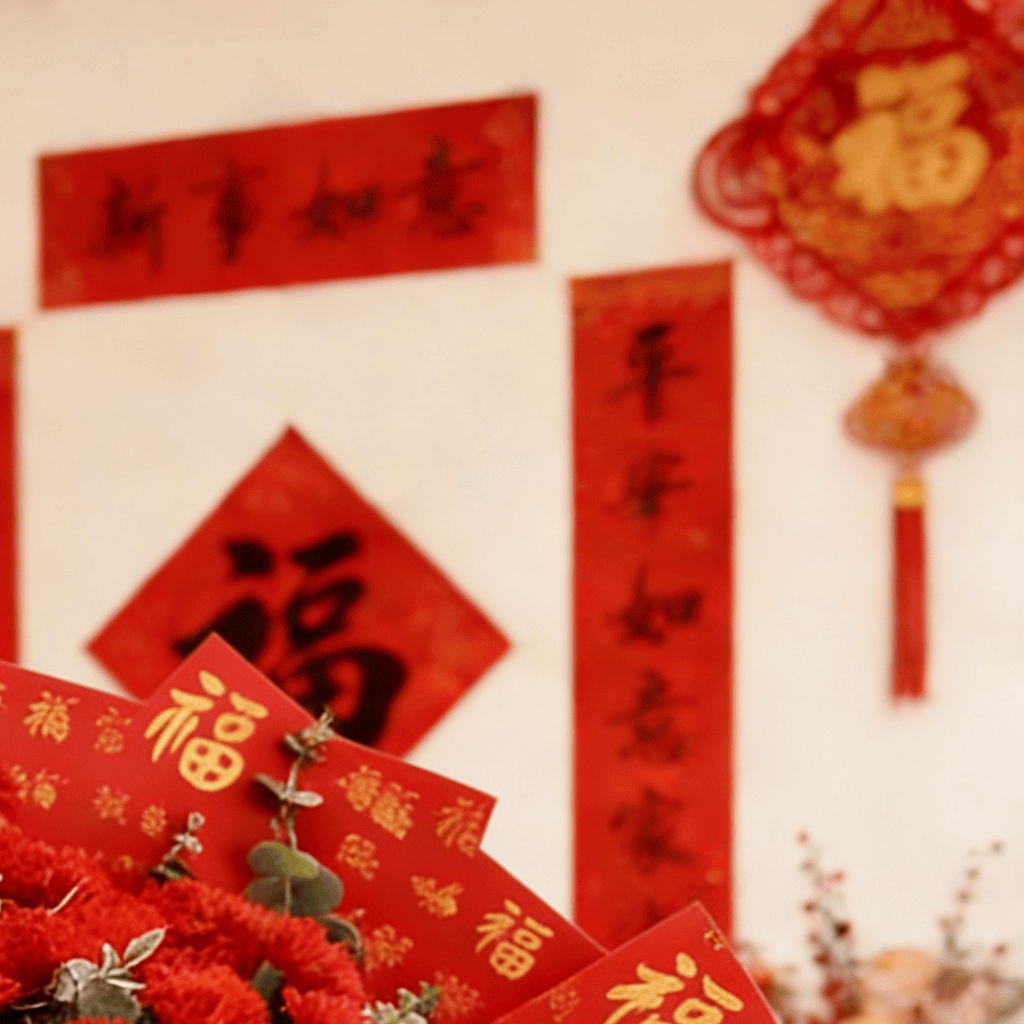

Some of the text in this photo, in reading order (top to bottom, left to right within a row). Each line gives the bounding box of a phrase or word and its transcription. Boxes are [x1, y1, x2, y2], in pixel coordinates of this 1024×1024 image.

[830, 52, 990, 216] 福
[169, 532, 408, 748] 福
[145, 670, 269, 792] 福
[476, 901, 554, 980] 福
